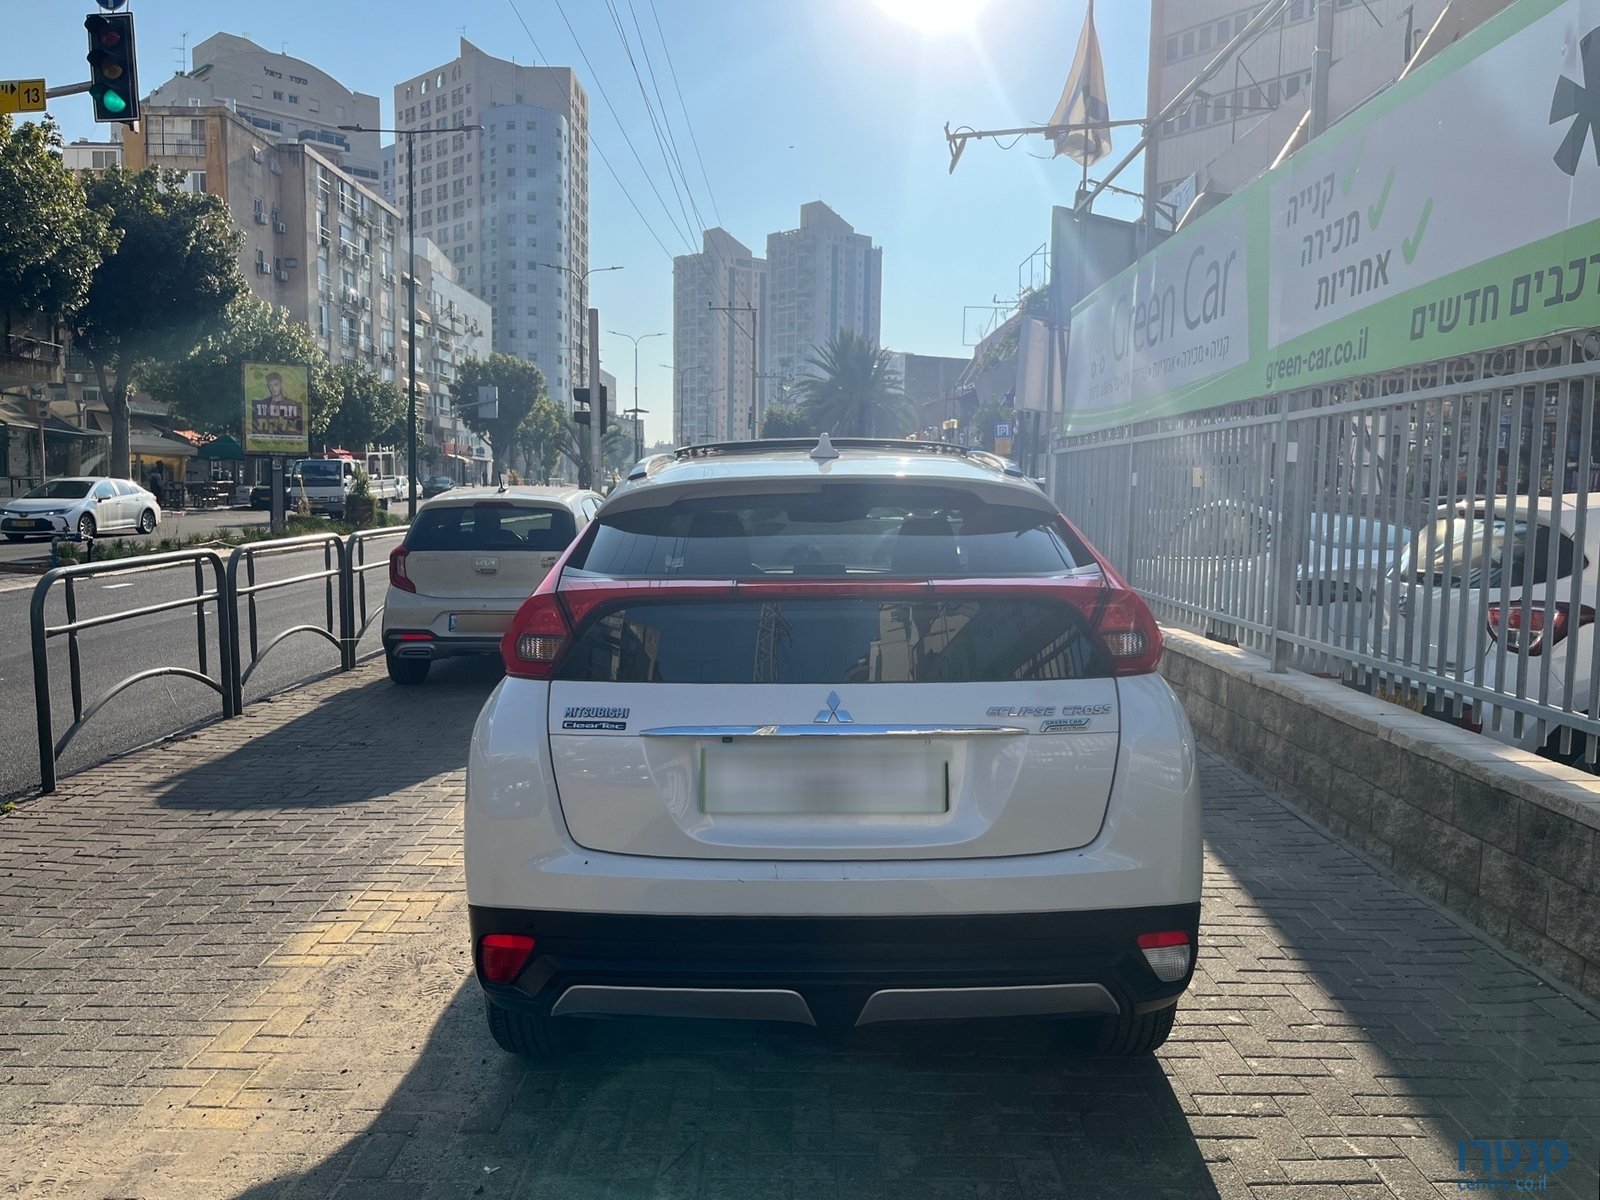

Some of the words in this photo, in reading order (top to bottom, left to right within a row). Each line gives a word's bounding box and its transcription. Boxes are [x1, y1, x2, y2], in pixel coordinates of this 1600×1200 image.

[24, 88, 40, 103] 13
[1286, 171, 1335, 228] קנייה
[1301, 210, 1360, 268] מכירה
[1183, 245, 1237, 331] Car
[1314, 248, 1392, 311] אחריות
[1409, 284, 1500, 341] חדשים
[1266, 325, 1369, 389] green-car.co.il
[563, 721, 625, 730] ClearTec
[564, 706, 630, 719] MITSUBISHI
[986, 705, 1056, 717] ECLIPSE
[1062, 703, 1113, 716] CROSS
